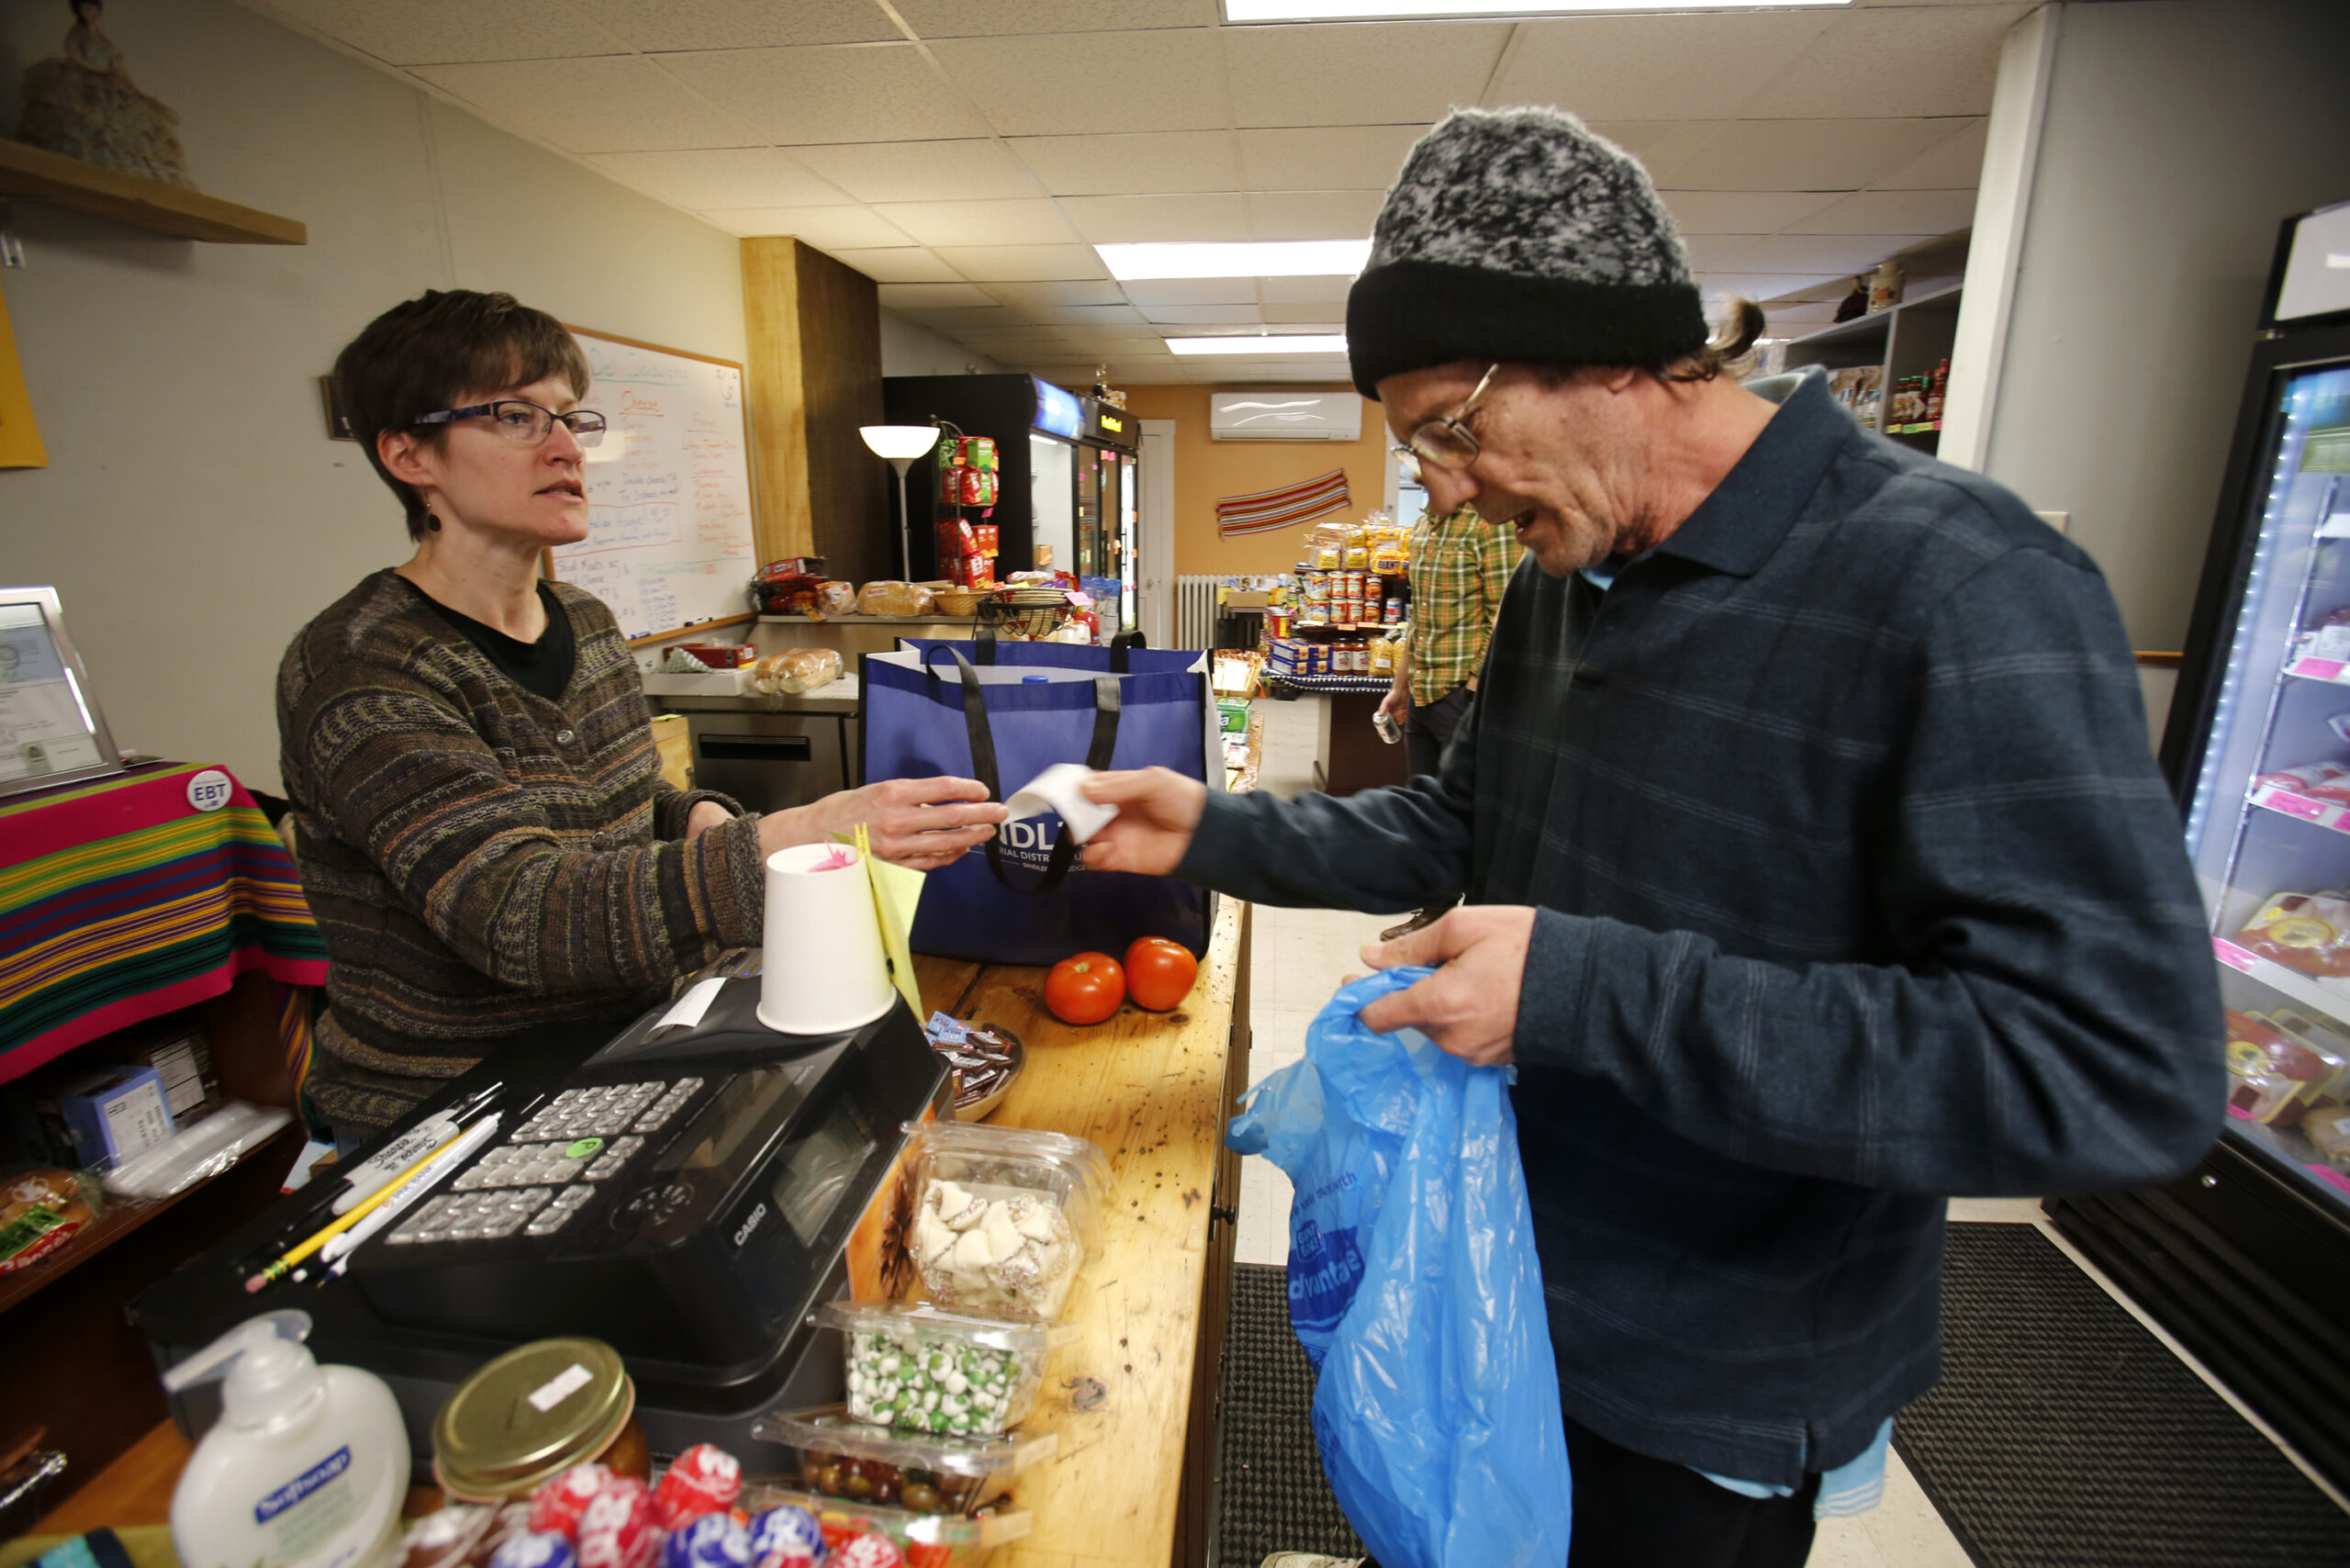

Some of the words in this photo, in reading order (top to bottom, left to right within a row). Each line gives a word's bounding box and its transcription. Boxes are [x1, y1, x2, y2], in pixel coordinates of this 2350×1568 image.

[194, 783, 227, 801] EBT
[1020, 851, 1050, 863] DISTR
[367, 1138, 410, 1170] Sharpie
[734, 1203, 767, 1247] CASIO
